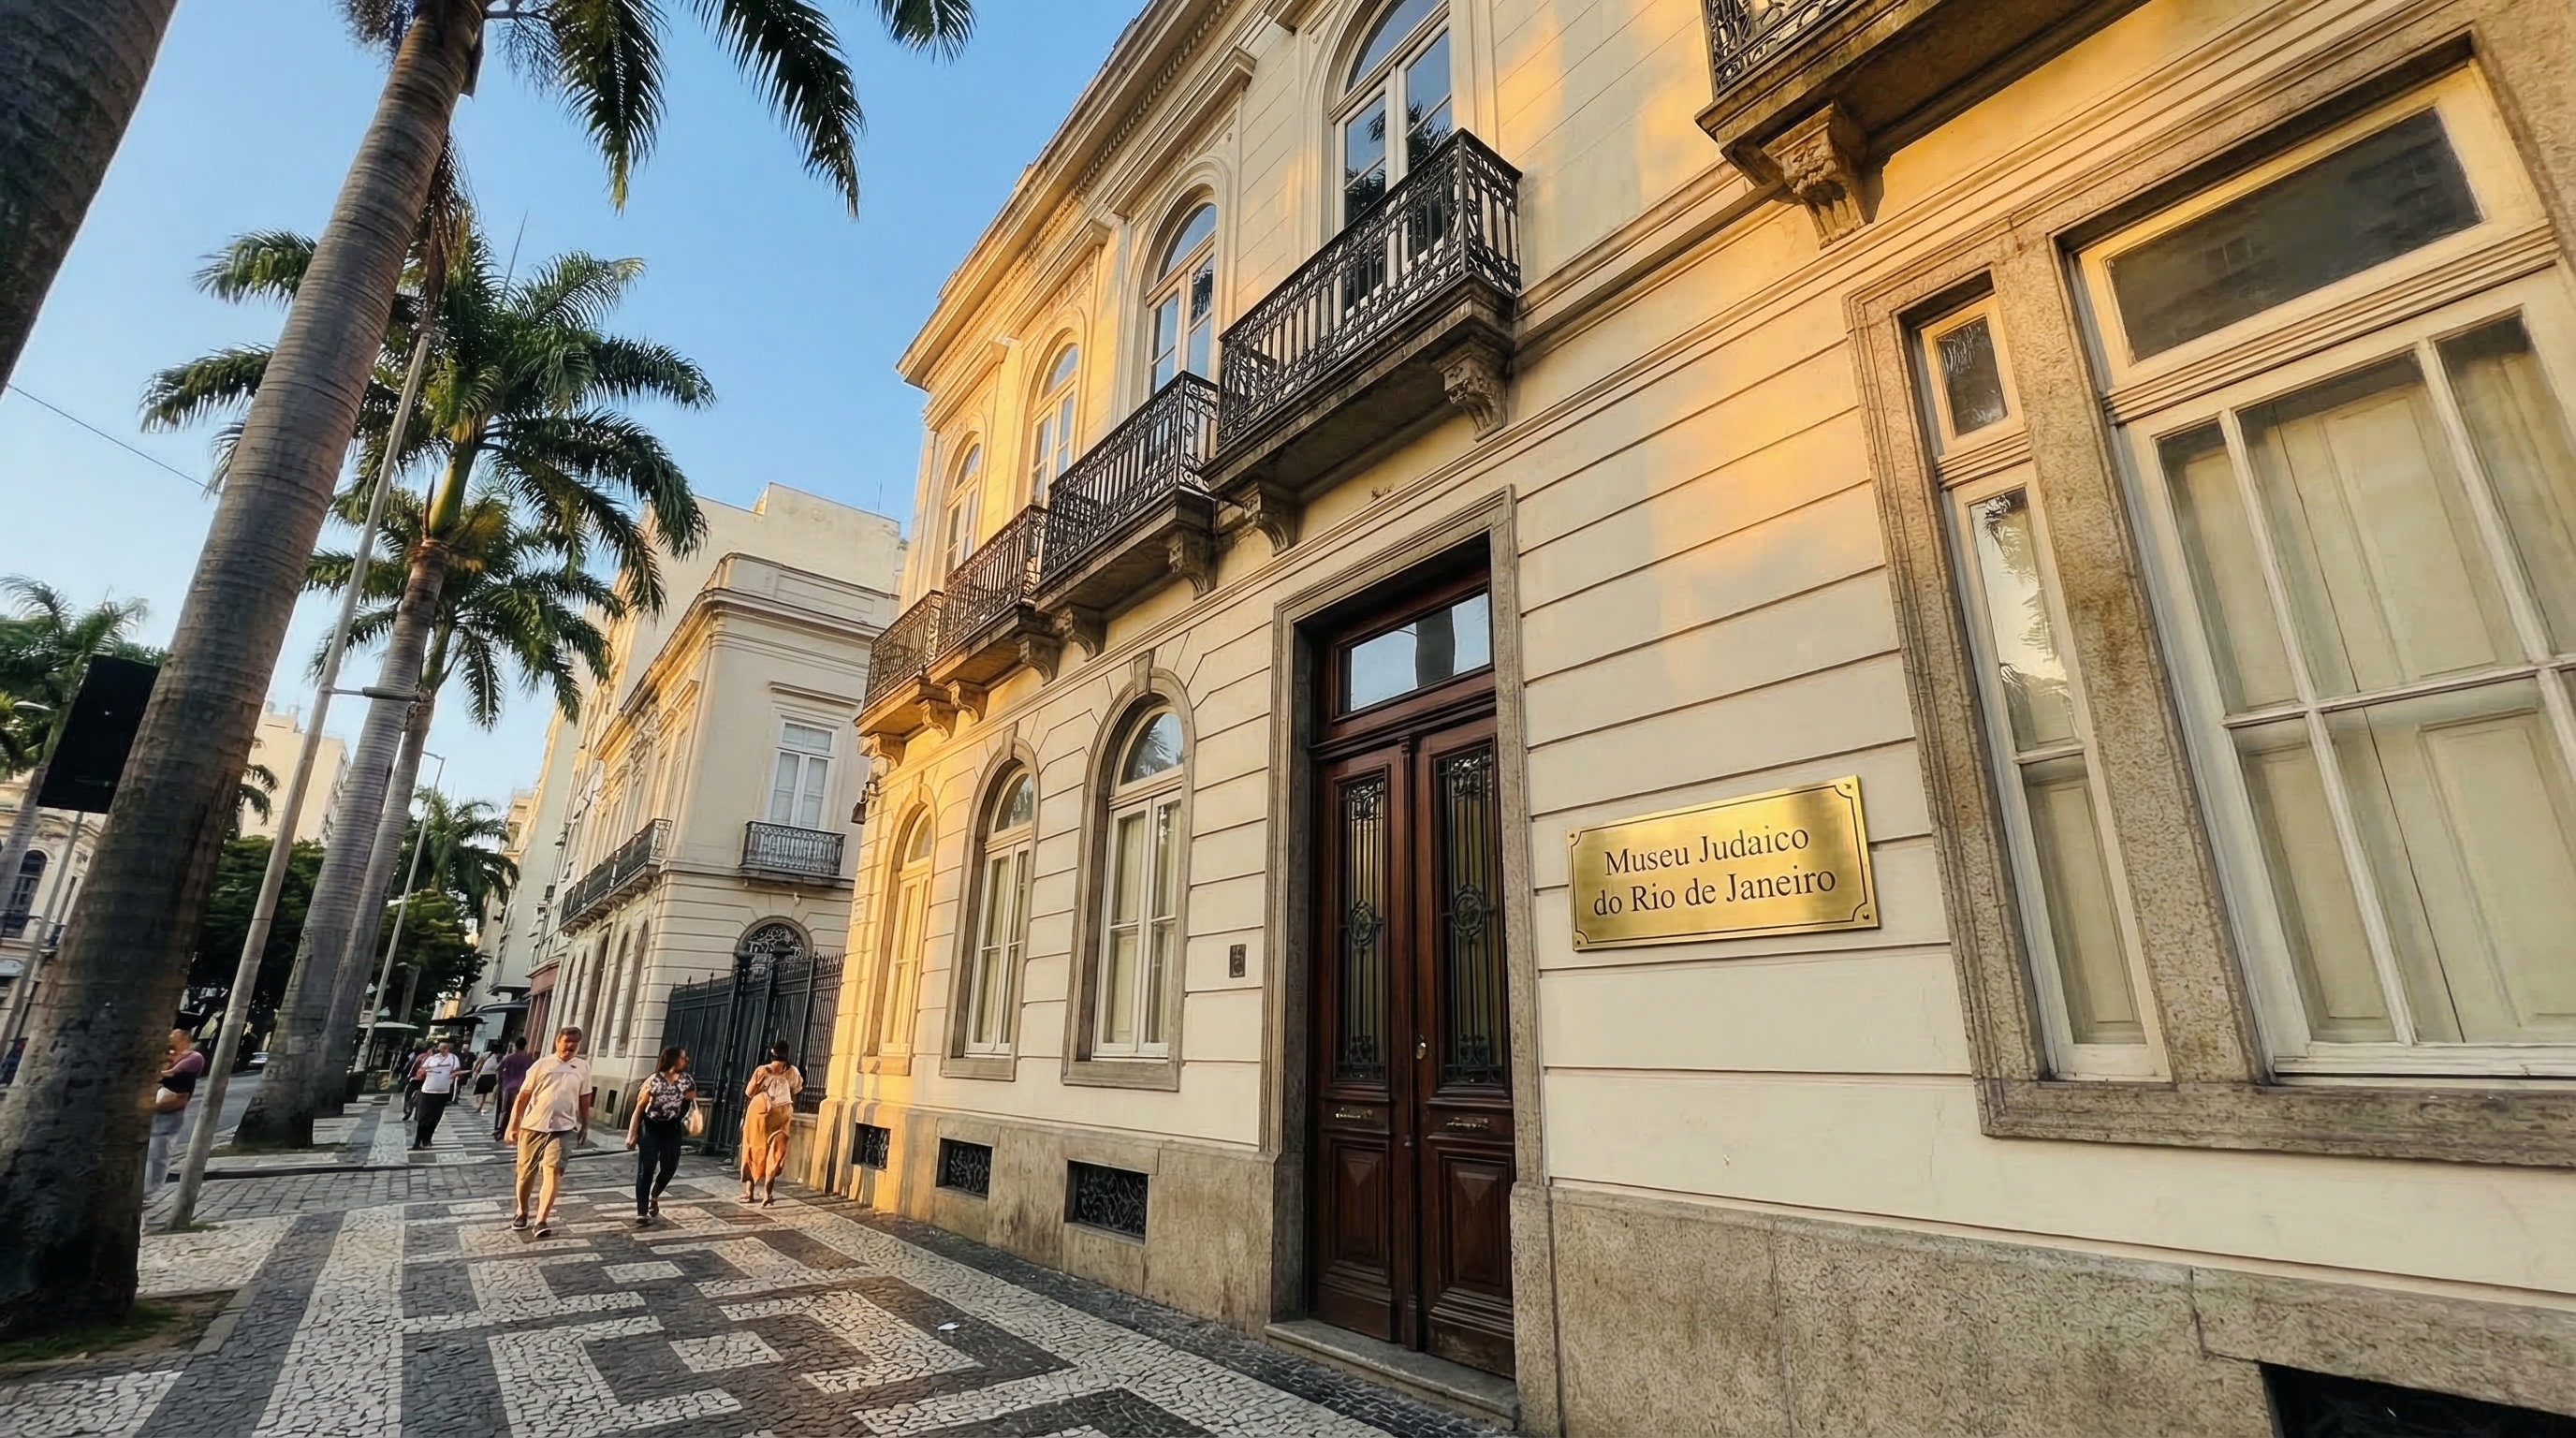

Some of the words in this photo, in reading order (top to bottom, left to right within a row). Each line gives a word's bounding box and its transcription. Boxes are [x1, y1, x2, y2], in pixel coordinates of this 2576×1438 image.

[1604, 845, 1690, 876] Museu
[1698, 826, 1809, 863] Judaico
[1593, 889, 1623, 917] do
[1630, 882, 1676, 912] Rio
[1685, 877, 1717, 906] de
[1725, 865, 1837, 902] Janeiro
